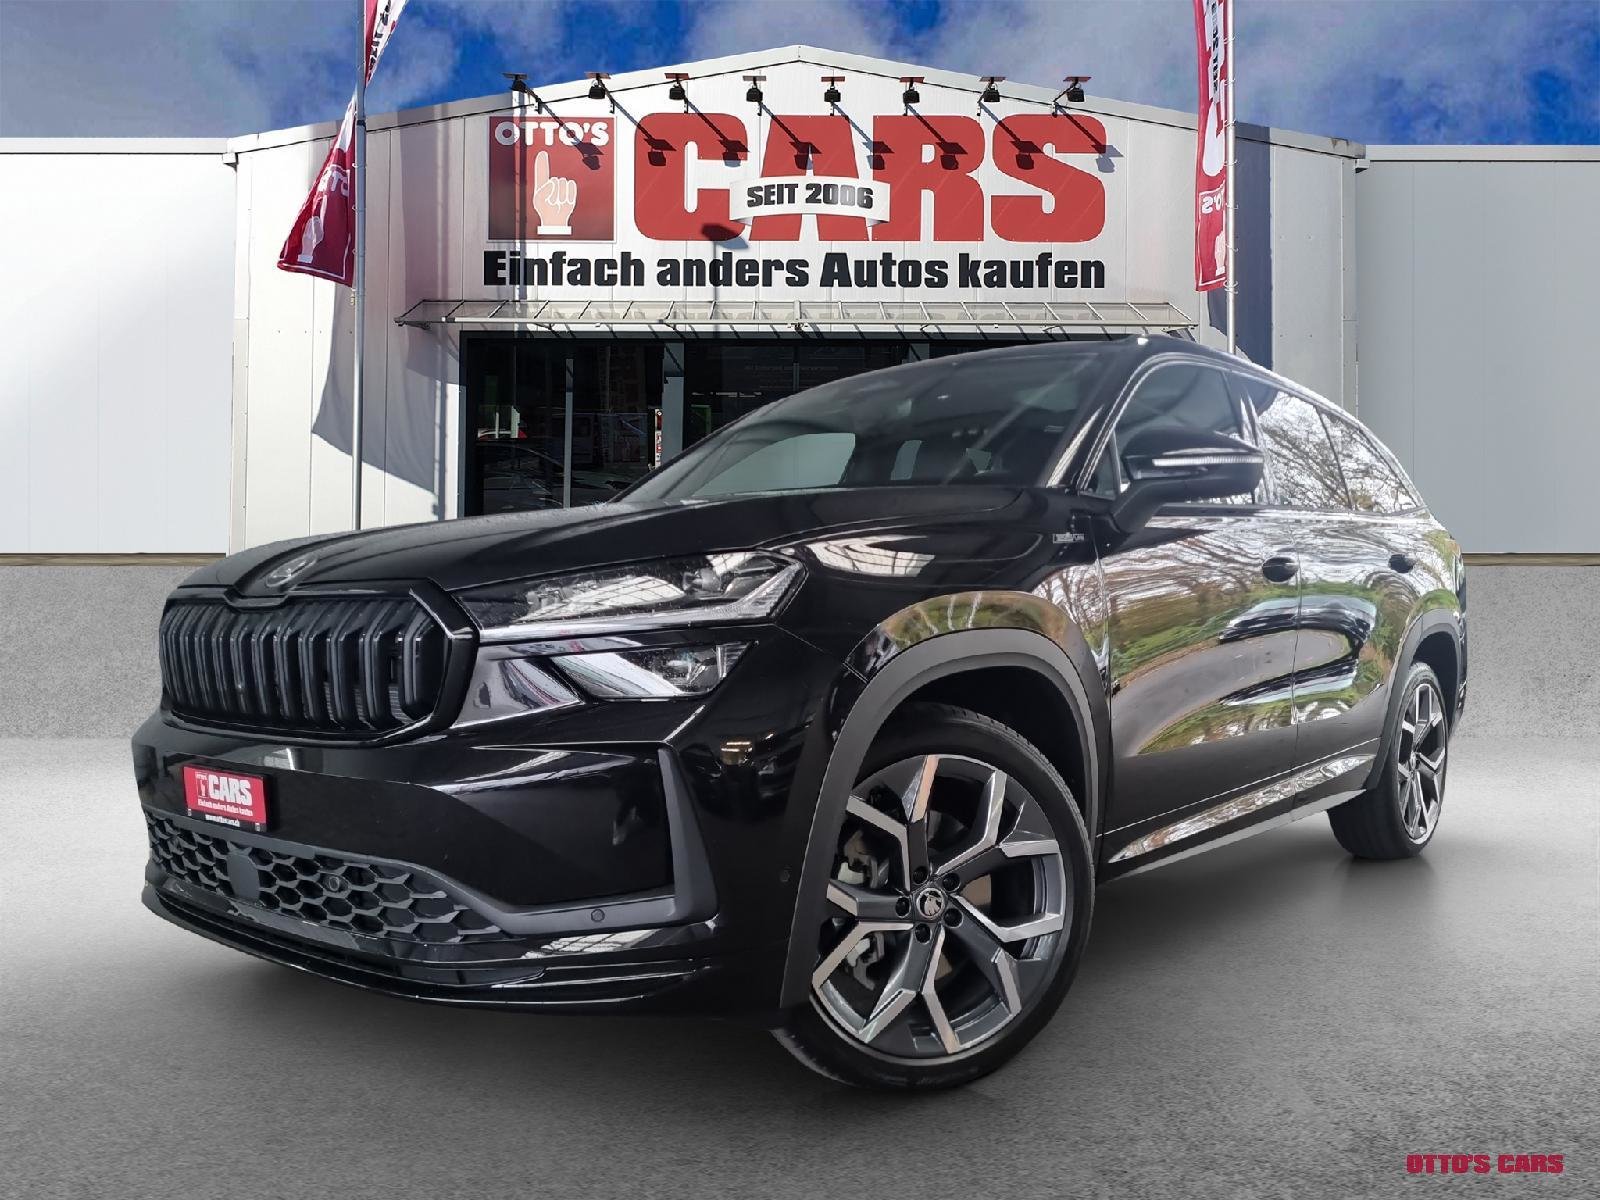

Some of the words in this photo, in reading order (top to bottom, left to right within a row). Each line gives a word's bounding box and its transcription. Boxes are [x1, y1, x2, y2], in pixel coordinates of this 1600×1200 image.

[494, 121, 609, 146] OTTO'S
[634, 113, 1106, 242] CARS
[747, 183, 798, 208] SEIT
[805, 183, 874, 209] 2006
[483, 250, 645, 287] Einfach
[656, 251, 809, 287] anders
[819, 252, 949, 289] Autos
[958, 252, 1105, 289] kaufen
[208, 774, 253, 806] CARS
